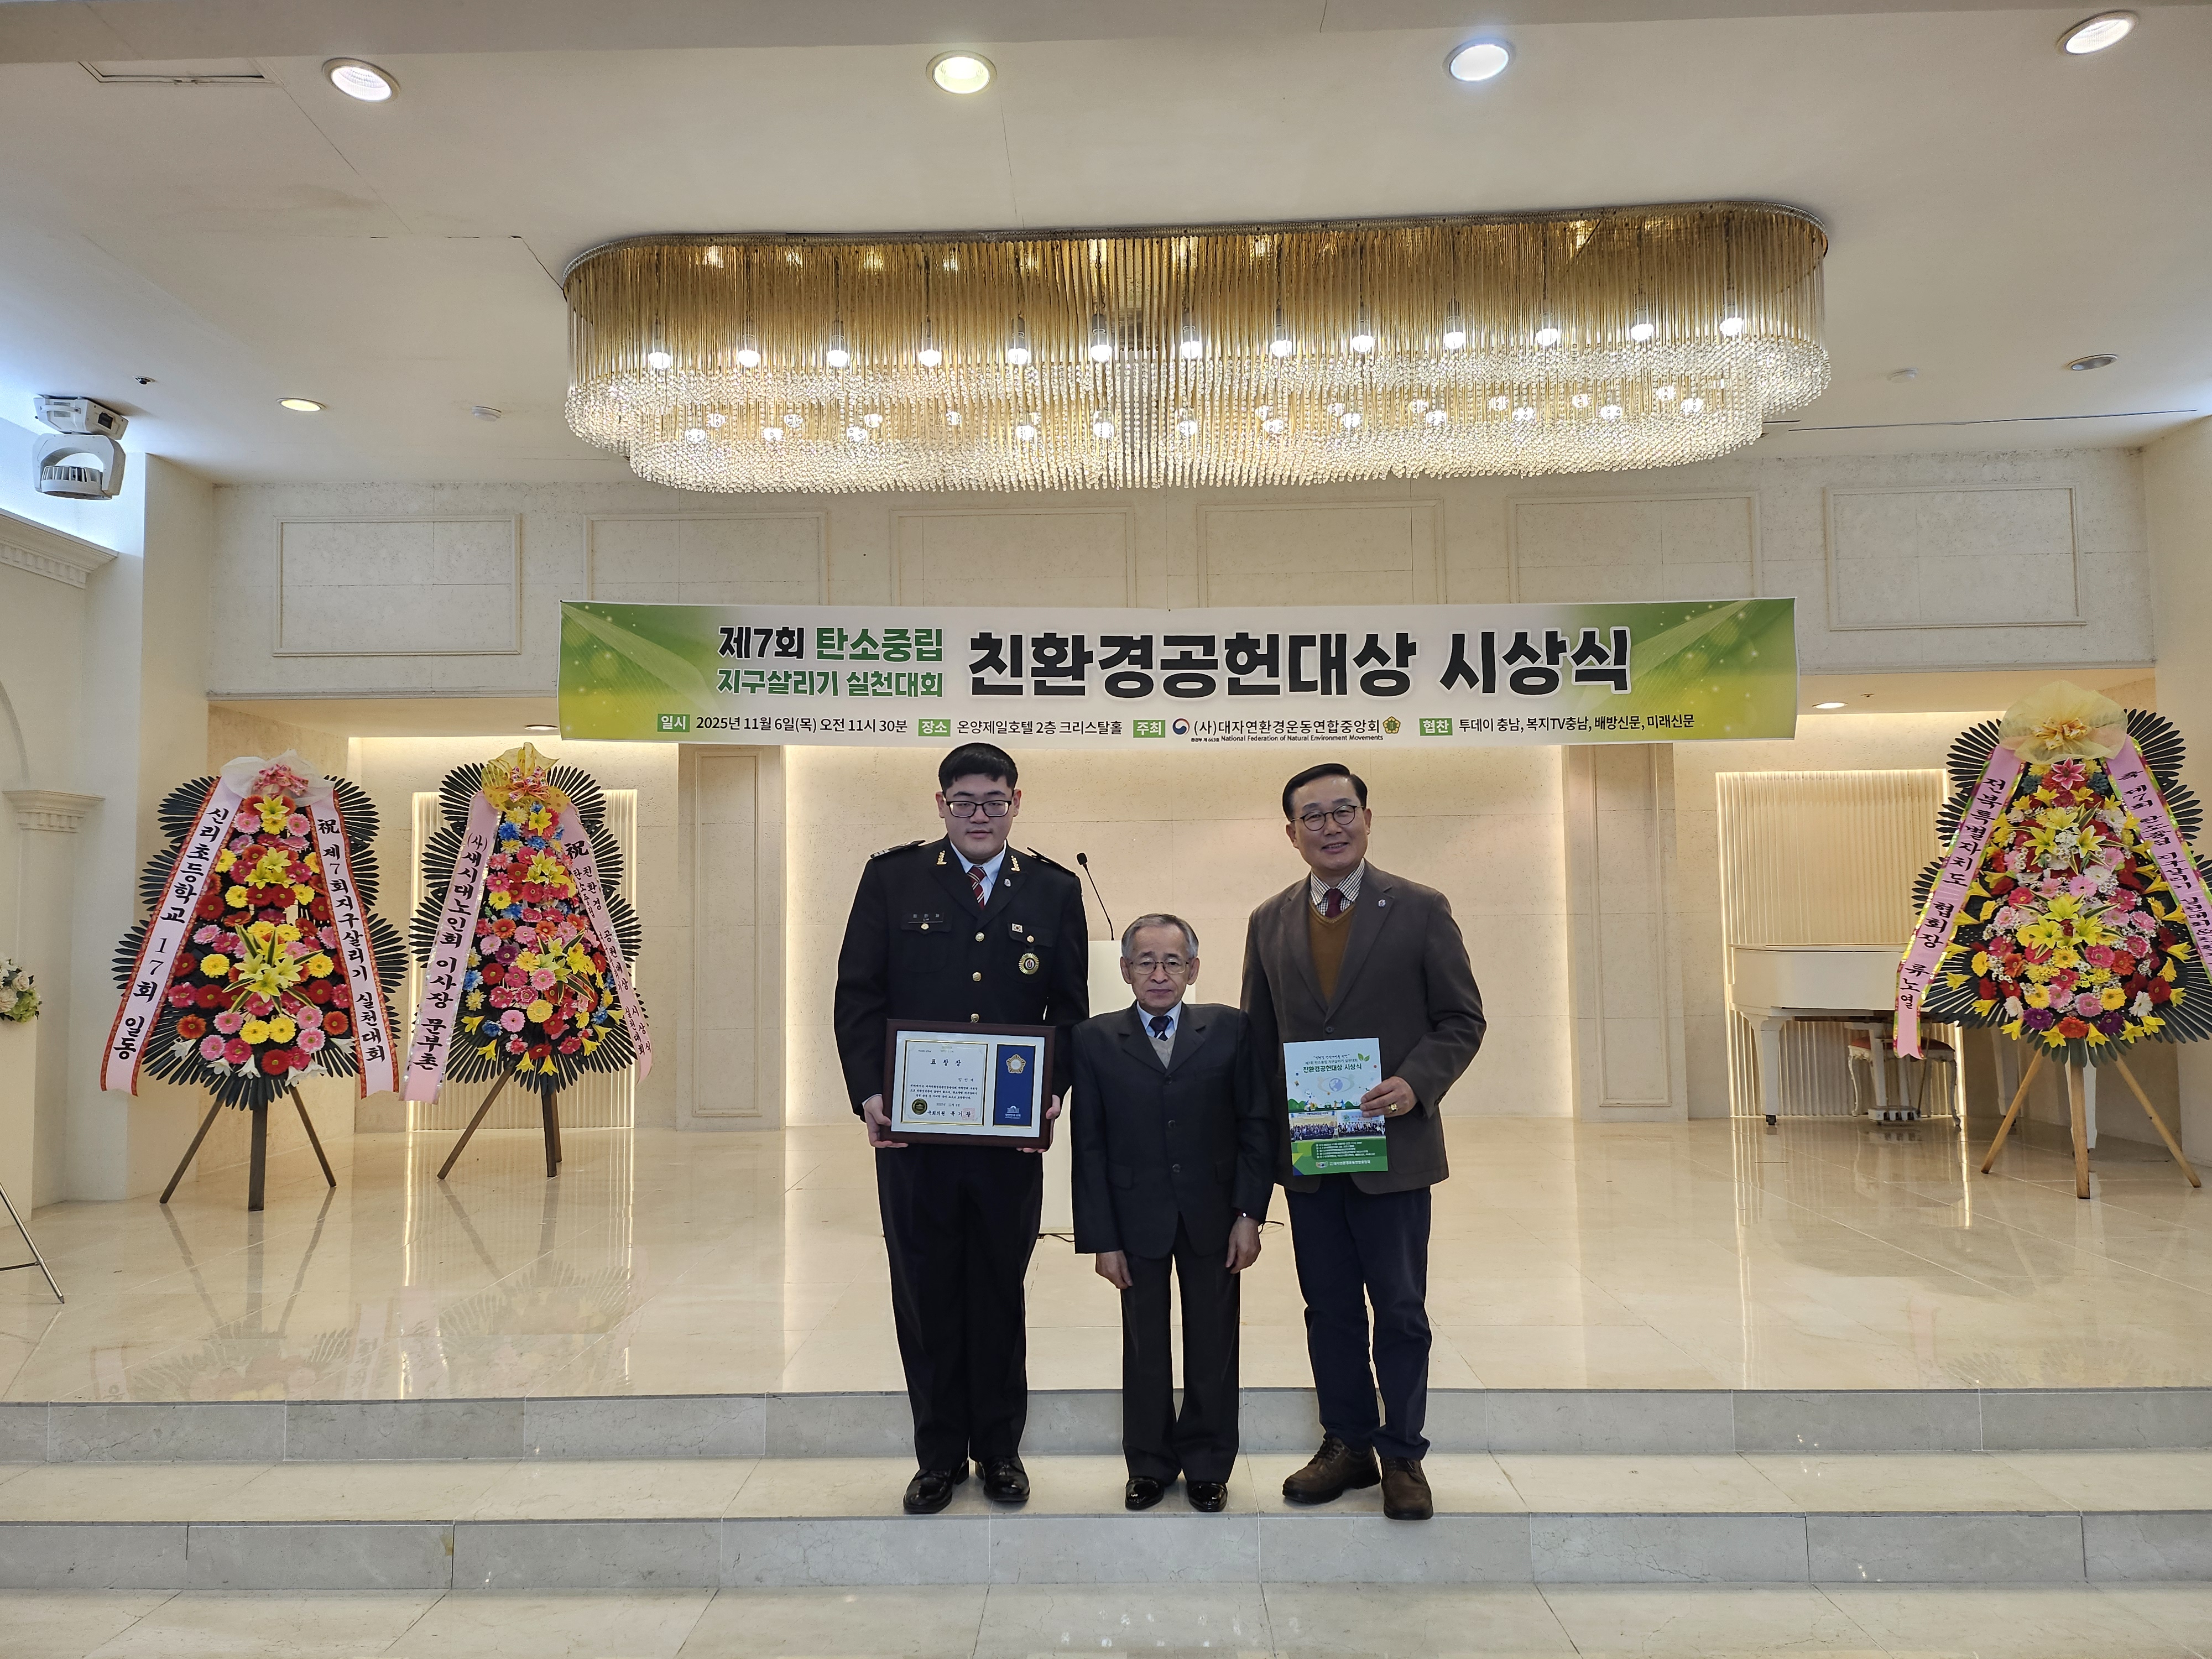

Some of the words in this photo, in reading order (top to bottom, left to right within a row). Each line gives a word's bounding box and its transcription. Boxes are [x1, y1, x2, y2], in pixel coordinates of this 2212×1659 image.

[718, 627, 805, 659] 제7회
[816, 628, 943, 662] 탄소중립
[969, 632, 1415, 697] 친환경공헌대상
[1439, 627, 1630, 695] 시상식
[718, 669, 838, 696] 지구살리기
[846, 671, 943, 698] 실천대회
[661, 716, 687, 730] 일시
[696, 717, 740, 731] 2025년
[744, 717, 771, 731] 11월
[775, 717, 817, 733] 6일(목)
[820, 718, 846, 732] 오전
[849, 719, 875, 733] 11시
[879, 719, 907, 733] 30분
[921, 721, 948, 734] 장소
[957, 720, 1033, 735] 온양제일호텔
[1036, 721, 1057, 734] 2층
[1059, 721, 1123, 735] 크리스탈홀
[1136, 722, 1162, 735] 주최
[1194, 720, 1380, 735] (사)대자연환경운동연합중앙회
[1422, 719, 1450, 734] 협찬
[1458, 718, 1494, 733] 투데이
[1496, 717, 1525, 733] 충남,
[1526, 717, 1593, 732] 복지TV충남,
[1594, 715, 1645, 731] 배방신문,
[1647, 714, 1695, 729] 미래신문
[2122, 784, 2154, 811] 제7회
[317, 818, 340, 836] 祝
[1942, 778, 2006, 888] 전북특별자치도
[160, 808, 229, 924] 신리초등학교
[564, 840, 590, 860] 祝
[1917, 901, 1955, 949] 협회장
[133, 937, 167, 1003] 17회
[573, 868, 596, 918] 탄소중립
[625, 1005, 646, 1055] 실천대회
[582, 865, 602, 911] 친환경
[632, 1004, 652, 1053] 시상식
[426, 957, 457, 1009] 이사장
[1900, 963, 1931, 1010] 류노열
[113, 1016, 145, 1060] 일동
[356, 992, 385, 1062] 실천대회
[413, 1018, 446, 1071] 문부촌
[1303, 1064, 1343, 1073] 친환경공헌대상
